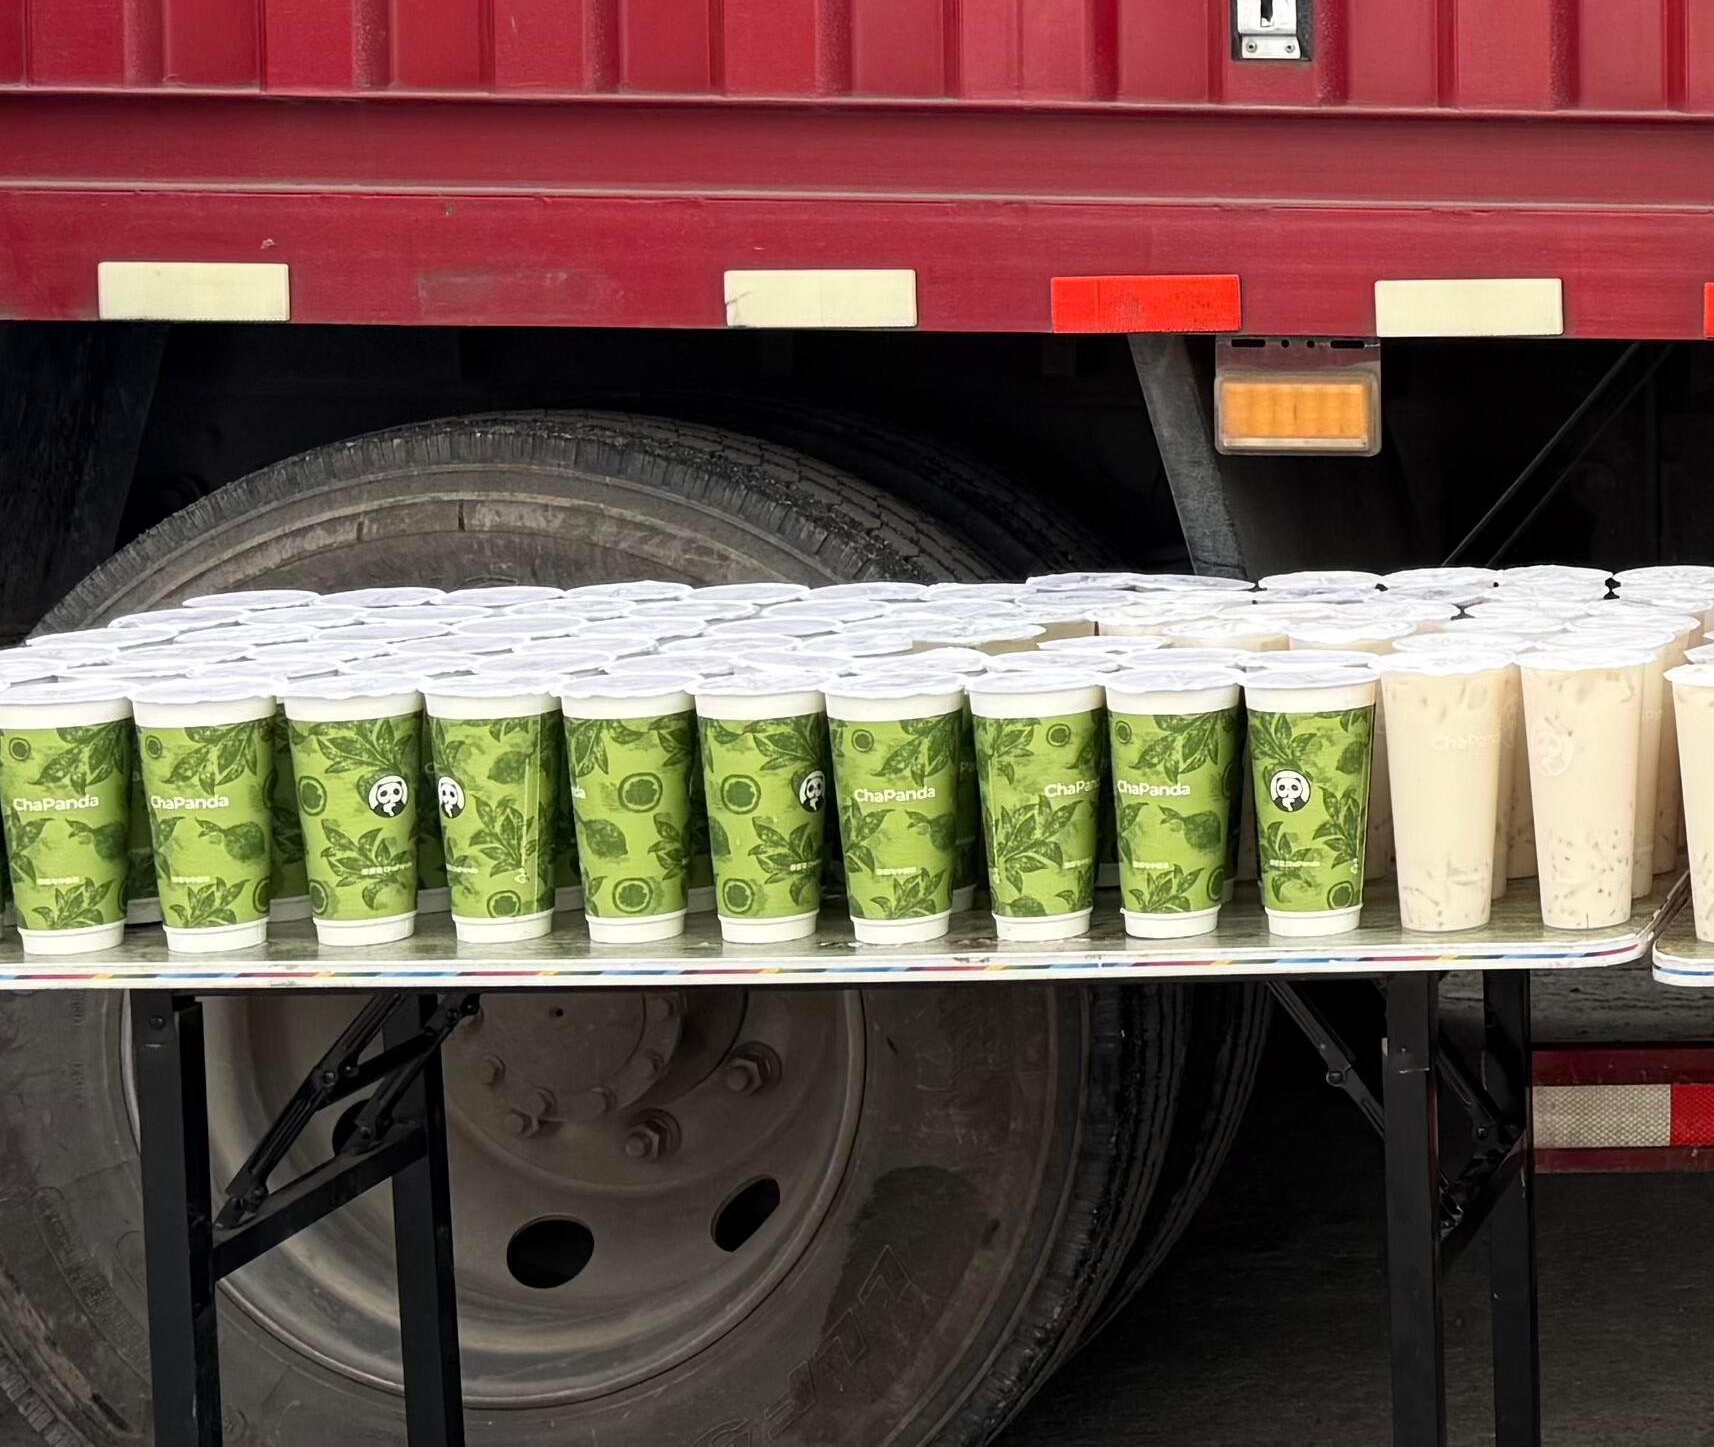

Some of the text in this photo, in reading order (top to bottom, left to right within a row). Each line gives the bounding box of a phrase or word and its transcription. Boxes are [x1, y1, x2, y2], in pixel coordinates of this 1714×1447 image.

[853, 785, 937, 803] ChaPanda
[1116, 779, 1191, 797] ChaPanda
[13, 794, 99, 812] ChaPanda
[150, 794, 229, 811] ChaPanda
